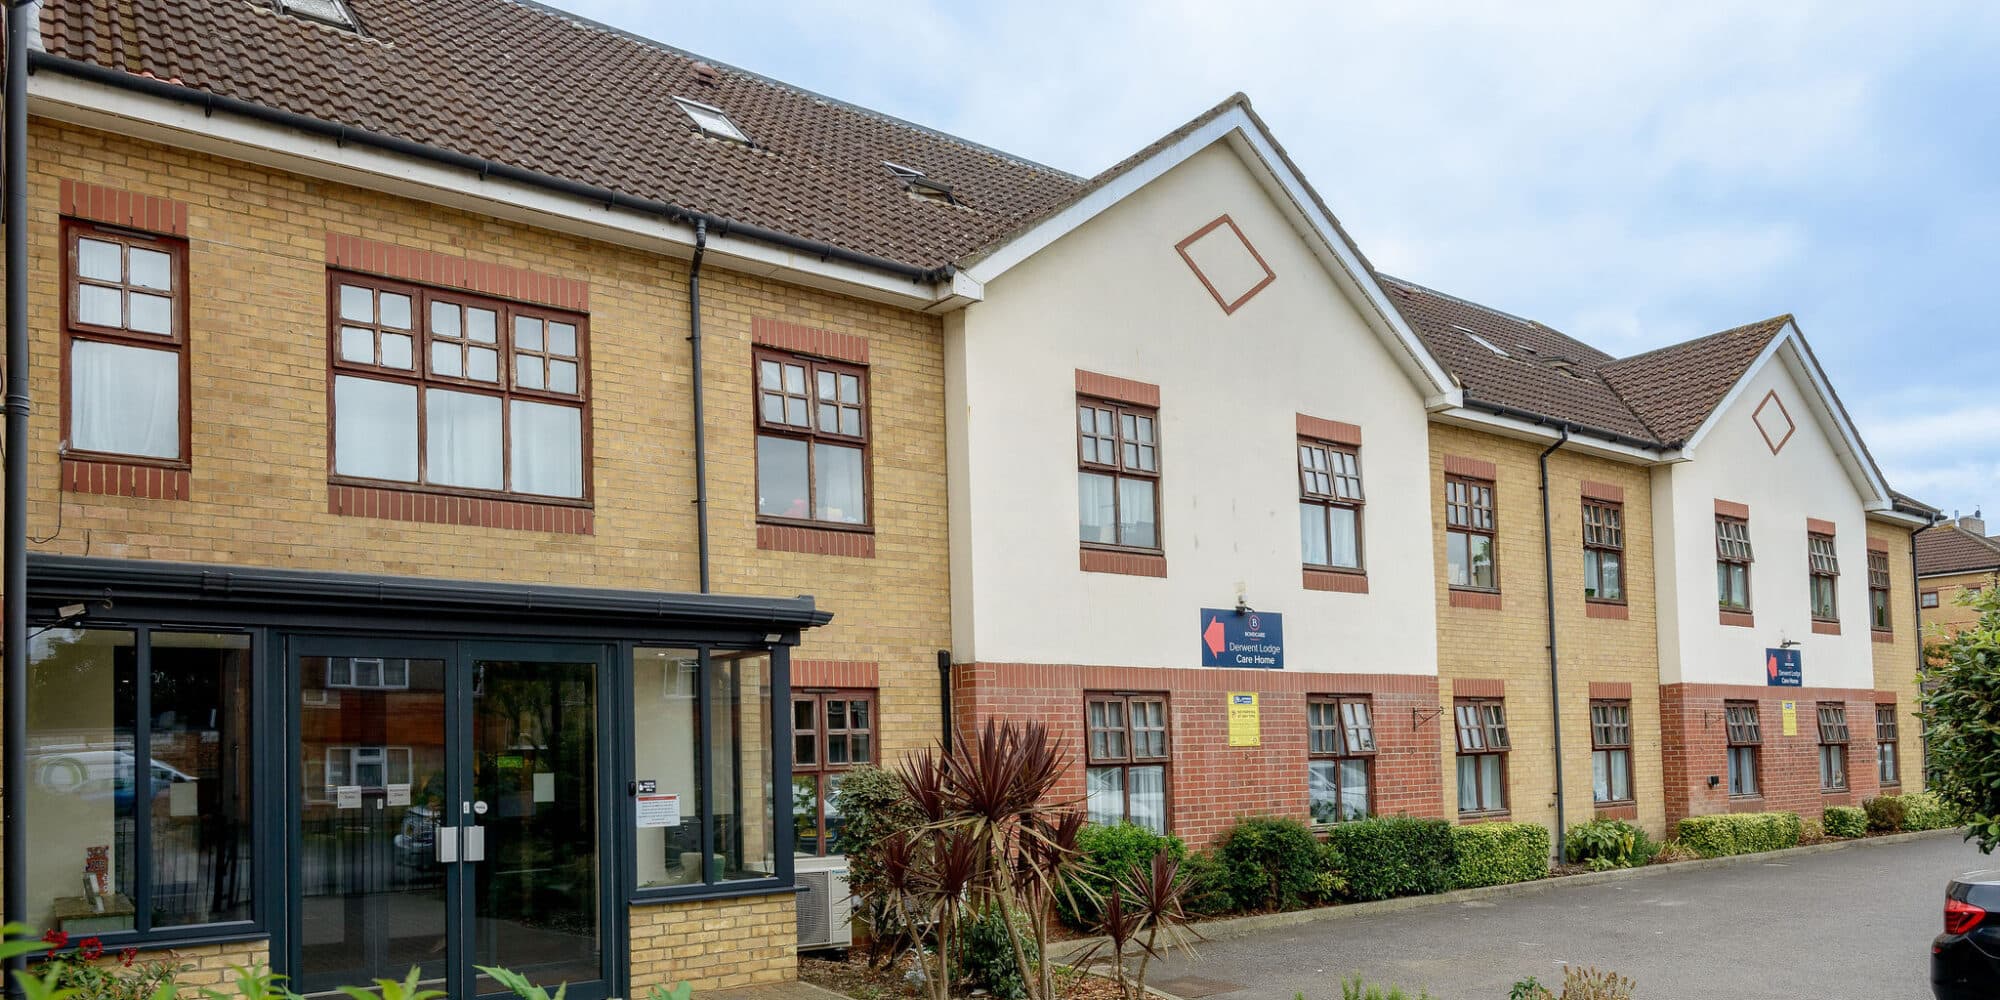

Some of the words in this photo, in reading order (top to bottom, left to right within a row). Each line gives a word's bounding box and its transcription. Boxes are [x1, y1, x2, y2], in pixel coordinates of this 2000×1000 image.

[1252, 618, 1258, 627] B
[1229, 642, 1258, 653] Derwent
[1260, 644, 1281, 655] Lodge
[1236, 654, 1253, 664] Care
[1254, 655, 1276, 665] Home
